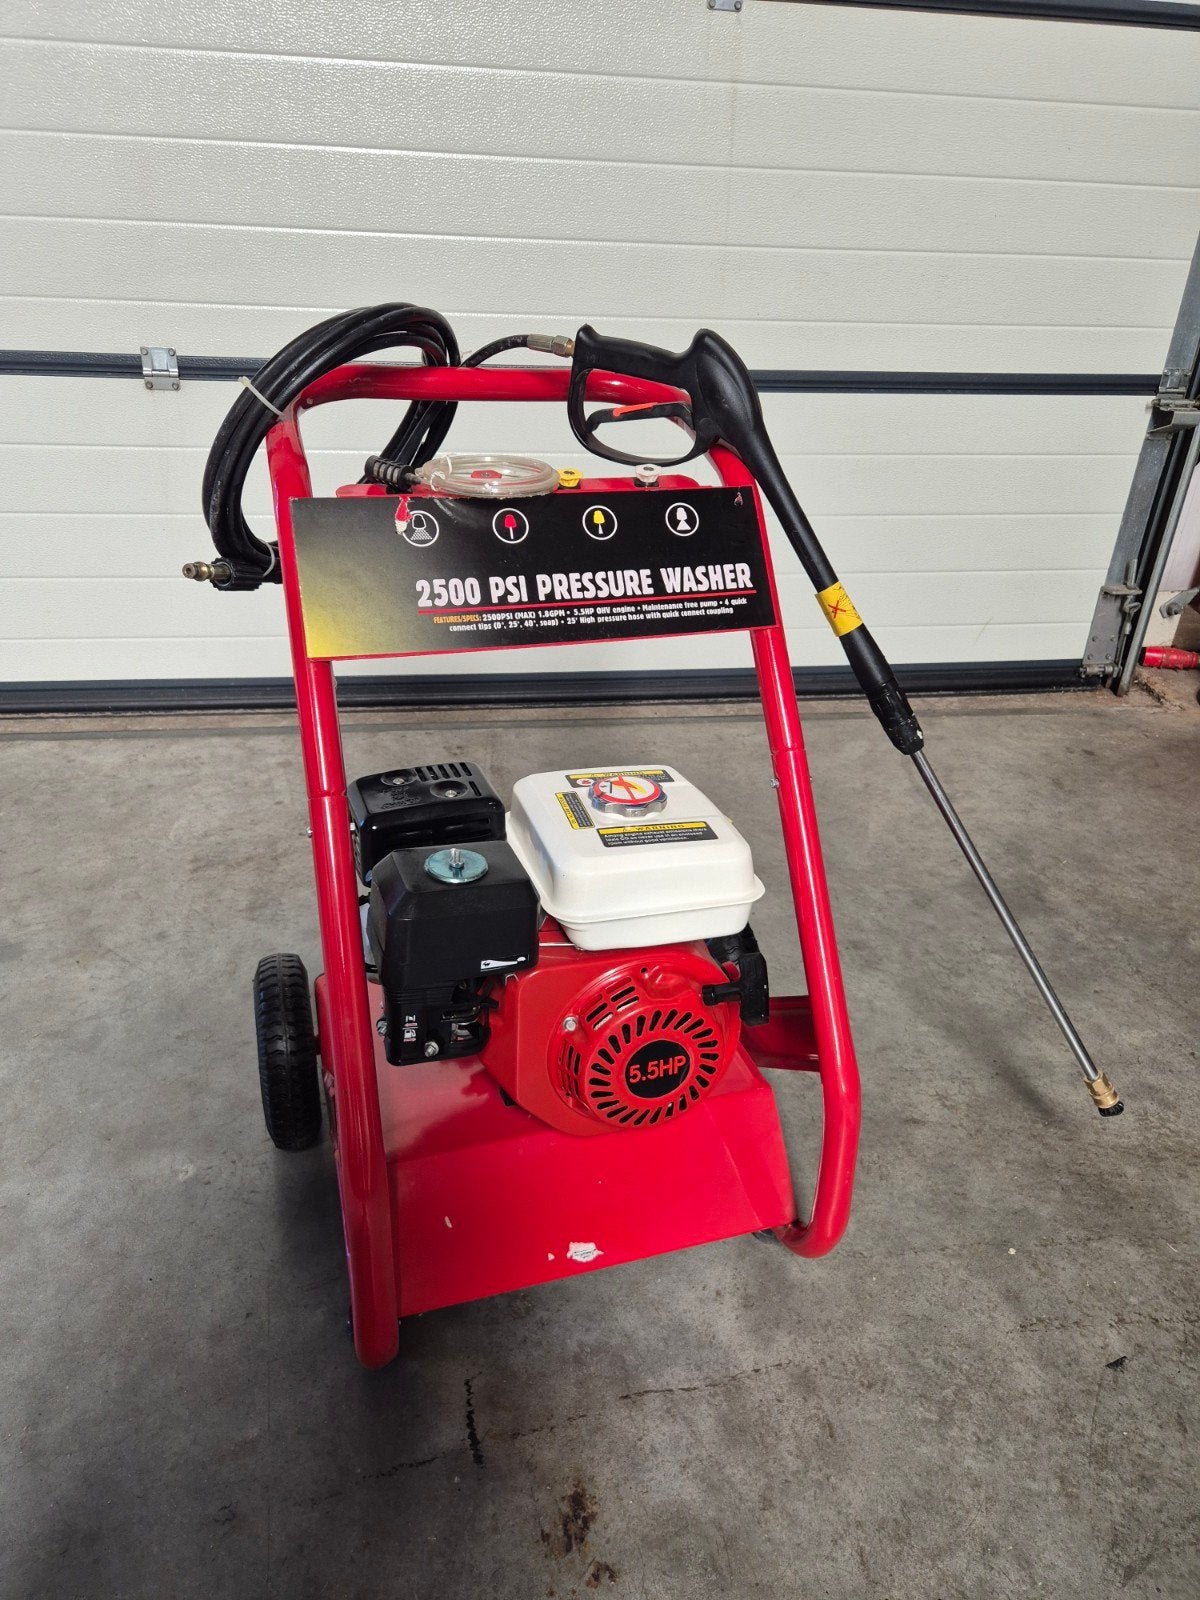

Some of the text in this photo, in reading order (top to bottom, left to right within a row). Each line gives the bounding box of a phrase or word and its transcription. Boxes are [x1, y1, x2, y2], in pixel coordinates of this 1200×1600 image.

[415, 562, 754, 608] 2500 PSI PRESSURE WASHER
[433, 614, 482, 624] FEATURES/SPECS:
[482, 612, 513, 622] 2500PSI
[514, 611, 536, 620] (MAX)
[538, 609, 566, 618] 1.8GPM
[573, 607, 595, 616] 5.5HP
[596, 606, 611, 614] OHV
[612, 605, 636, 614] engine
[642, 601, 683, 611] Maintenance
[699, 600, 718, 608] pump
[730, 597, 748, 605] quick
[449, 623, 477, 632] connect
[540, 618, 559, 627] soap)
[580, 615, 596, 624] High
[597, 614, 627, 623] pressure
[628, 613, 644, 621] hose
[645, 611, 661, 619] with
[662, 610, 680, 618] quick
[681, 608, 706, 617] connect
[706, 606, 734, 615] coupling
[629, 1055, 687, 1084] 5.5HP
